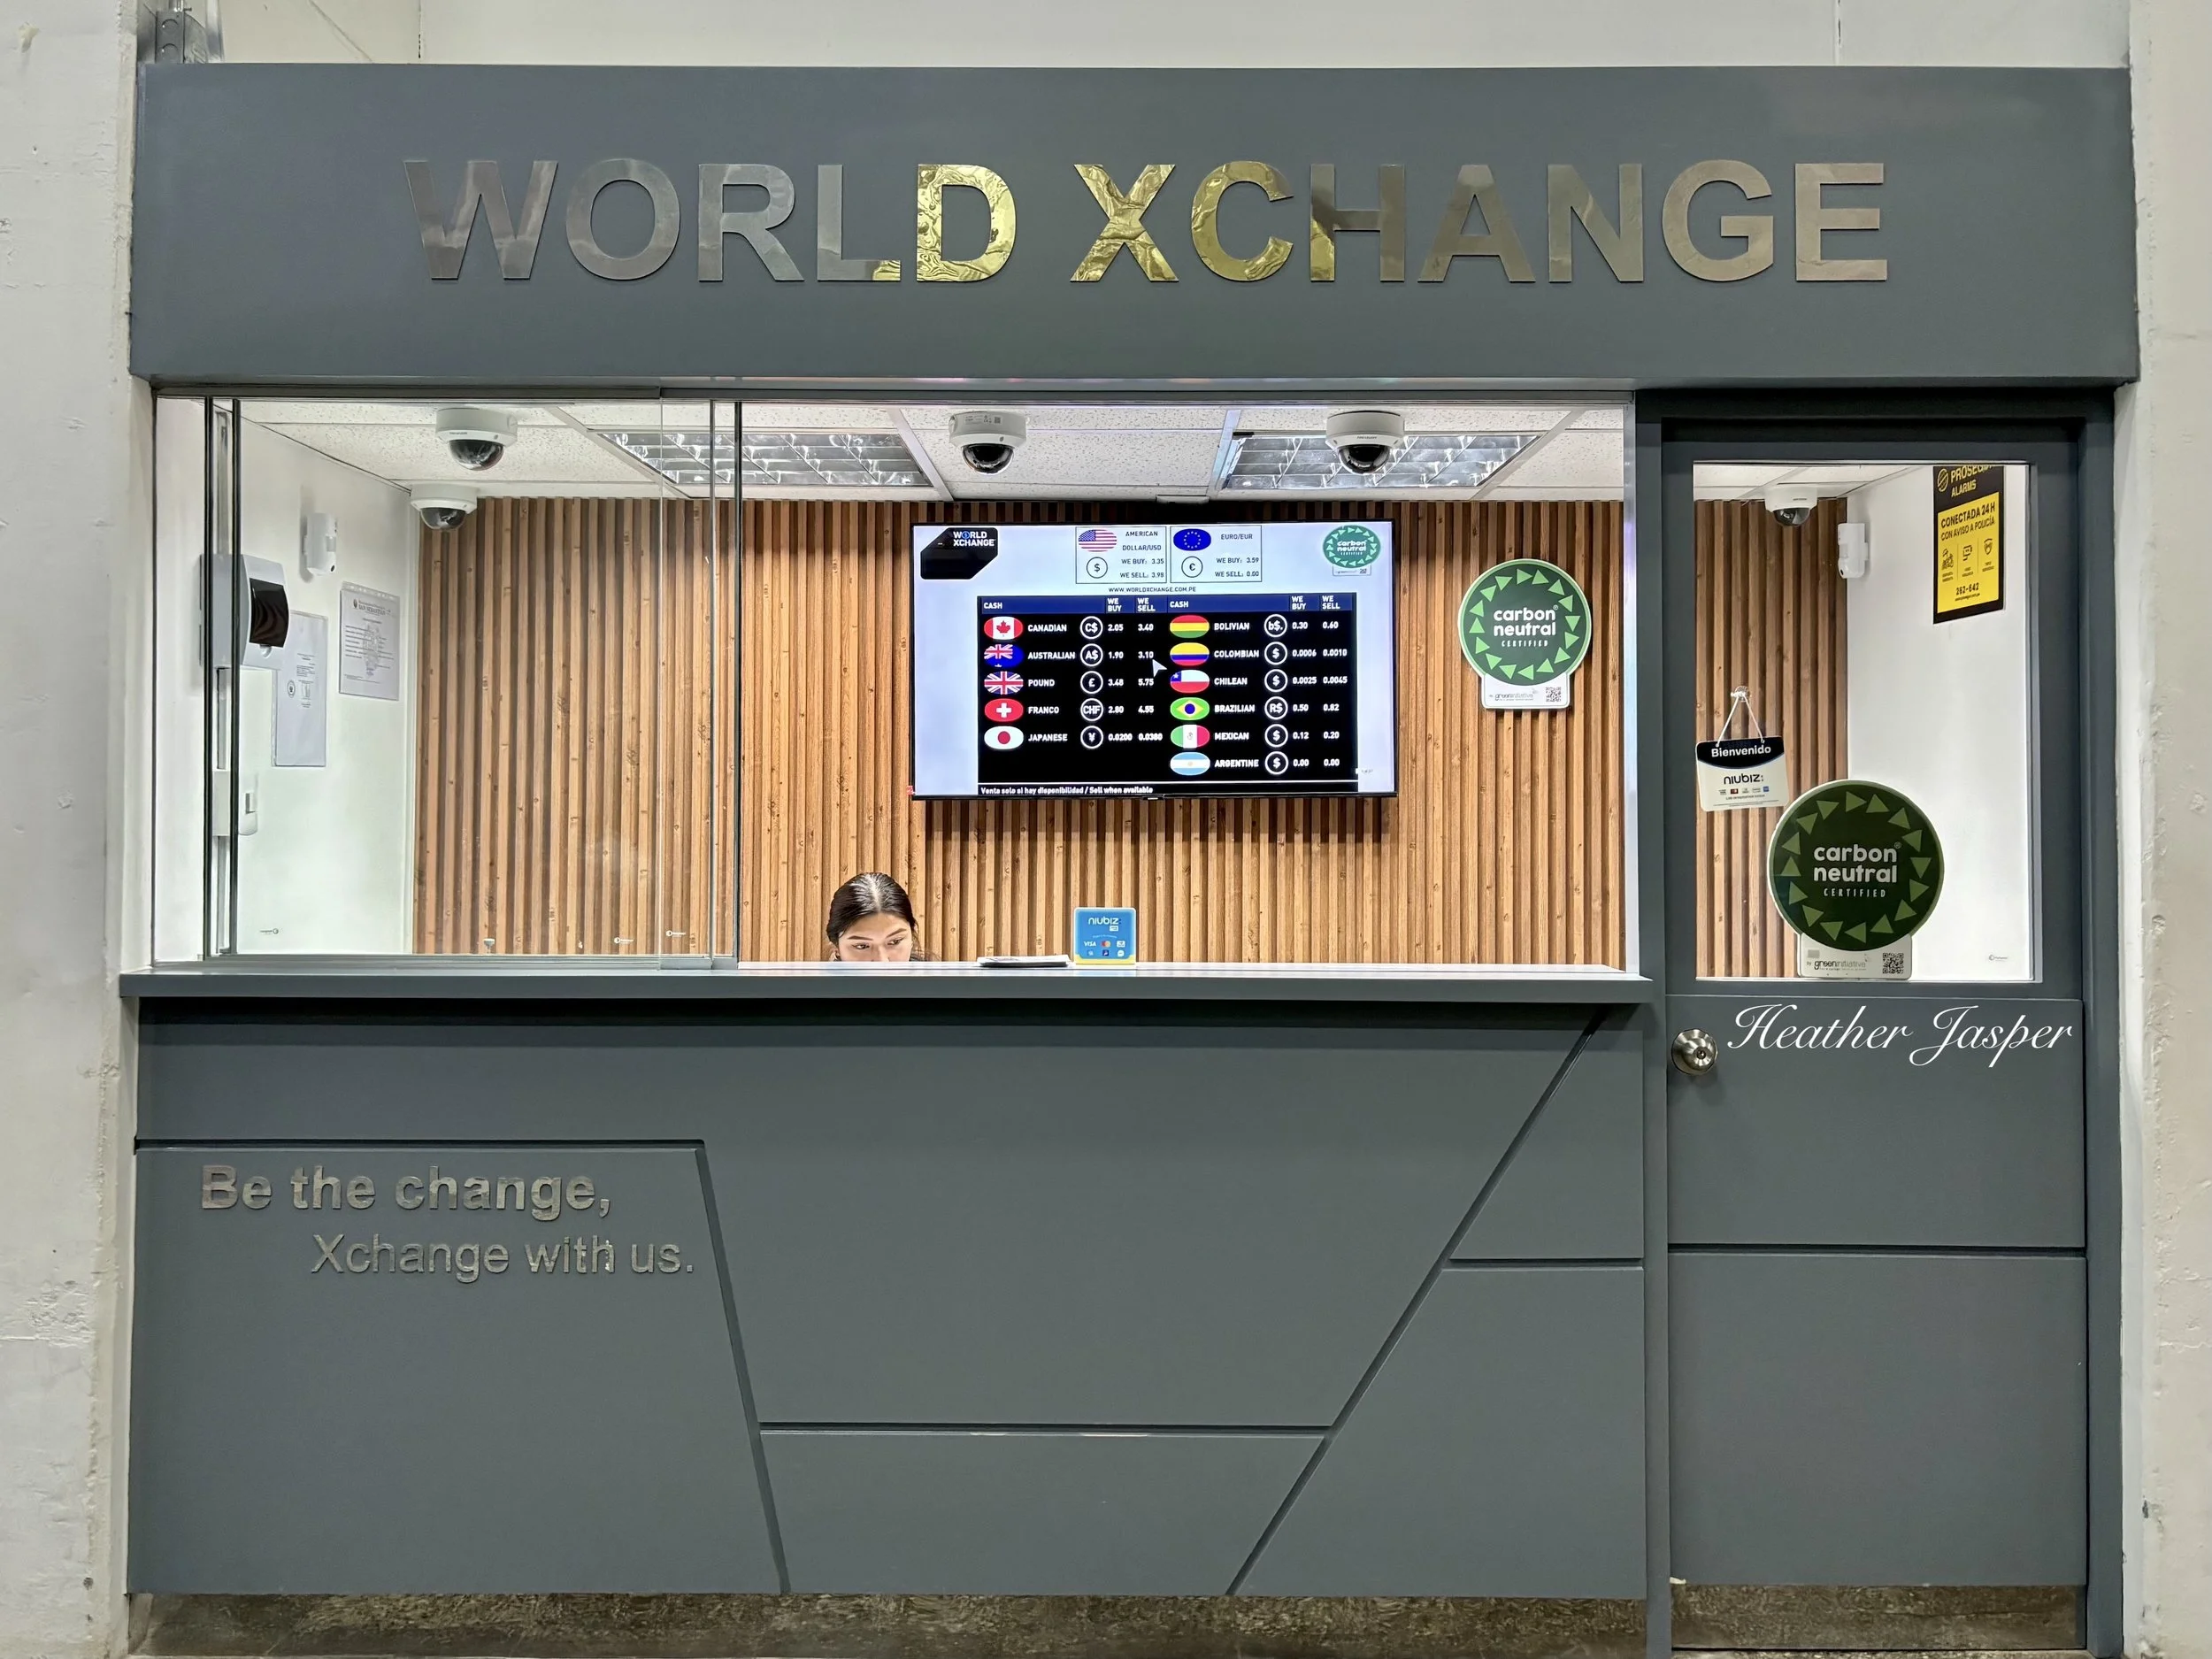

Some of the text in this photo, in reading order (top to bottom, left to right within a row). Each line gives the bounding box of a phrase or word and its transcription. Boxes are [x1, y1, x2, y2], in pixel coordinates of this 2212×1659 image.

[403, 158, 1888, 283] WORLD XCHANGE
[1951, 465, 1993, 483] PROSEG
[1951, 479, 1977, 497] ALARMS
[1940, 507, 1981, 528] CONECTADA
[1940, 531, 1953, 541] CON
[1954, 525, 1970, 537] AVISO
[1970, 523, 1974, 532] A
[1494, 607, 1556, 621] carbon
[1085, 623, 1098, 634] C$
[1494, 622, 1556, 636] neutral
[1027, 651, 1076, 660] AUSTRALIAN
[1085, 650, 1099, 661] A$
[1214, 649, 1259, 658] COLOMBIAN
[1214, 677, 1248, 686] CHILEAN
[1083, 705, 1101, 714] CHF
[1711, 744, 1771, 758] Bienvenido
[1814, 844, 1897, 862] carbon
[1814, 864, 1897, 883] neutral
[1824, 887, 1886, 898] CERTIFIED
[201, 1164, 612, 1222] Be the change,
[311, 1233, 694, 1284] Xchange with us.
